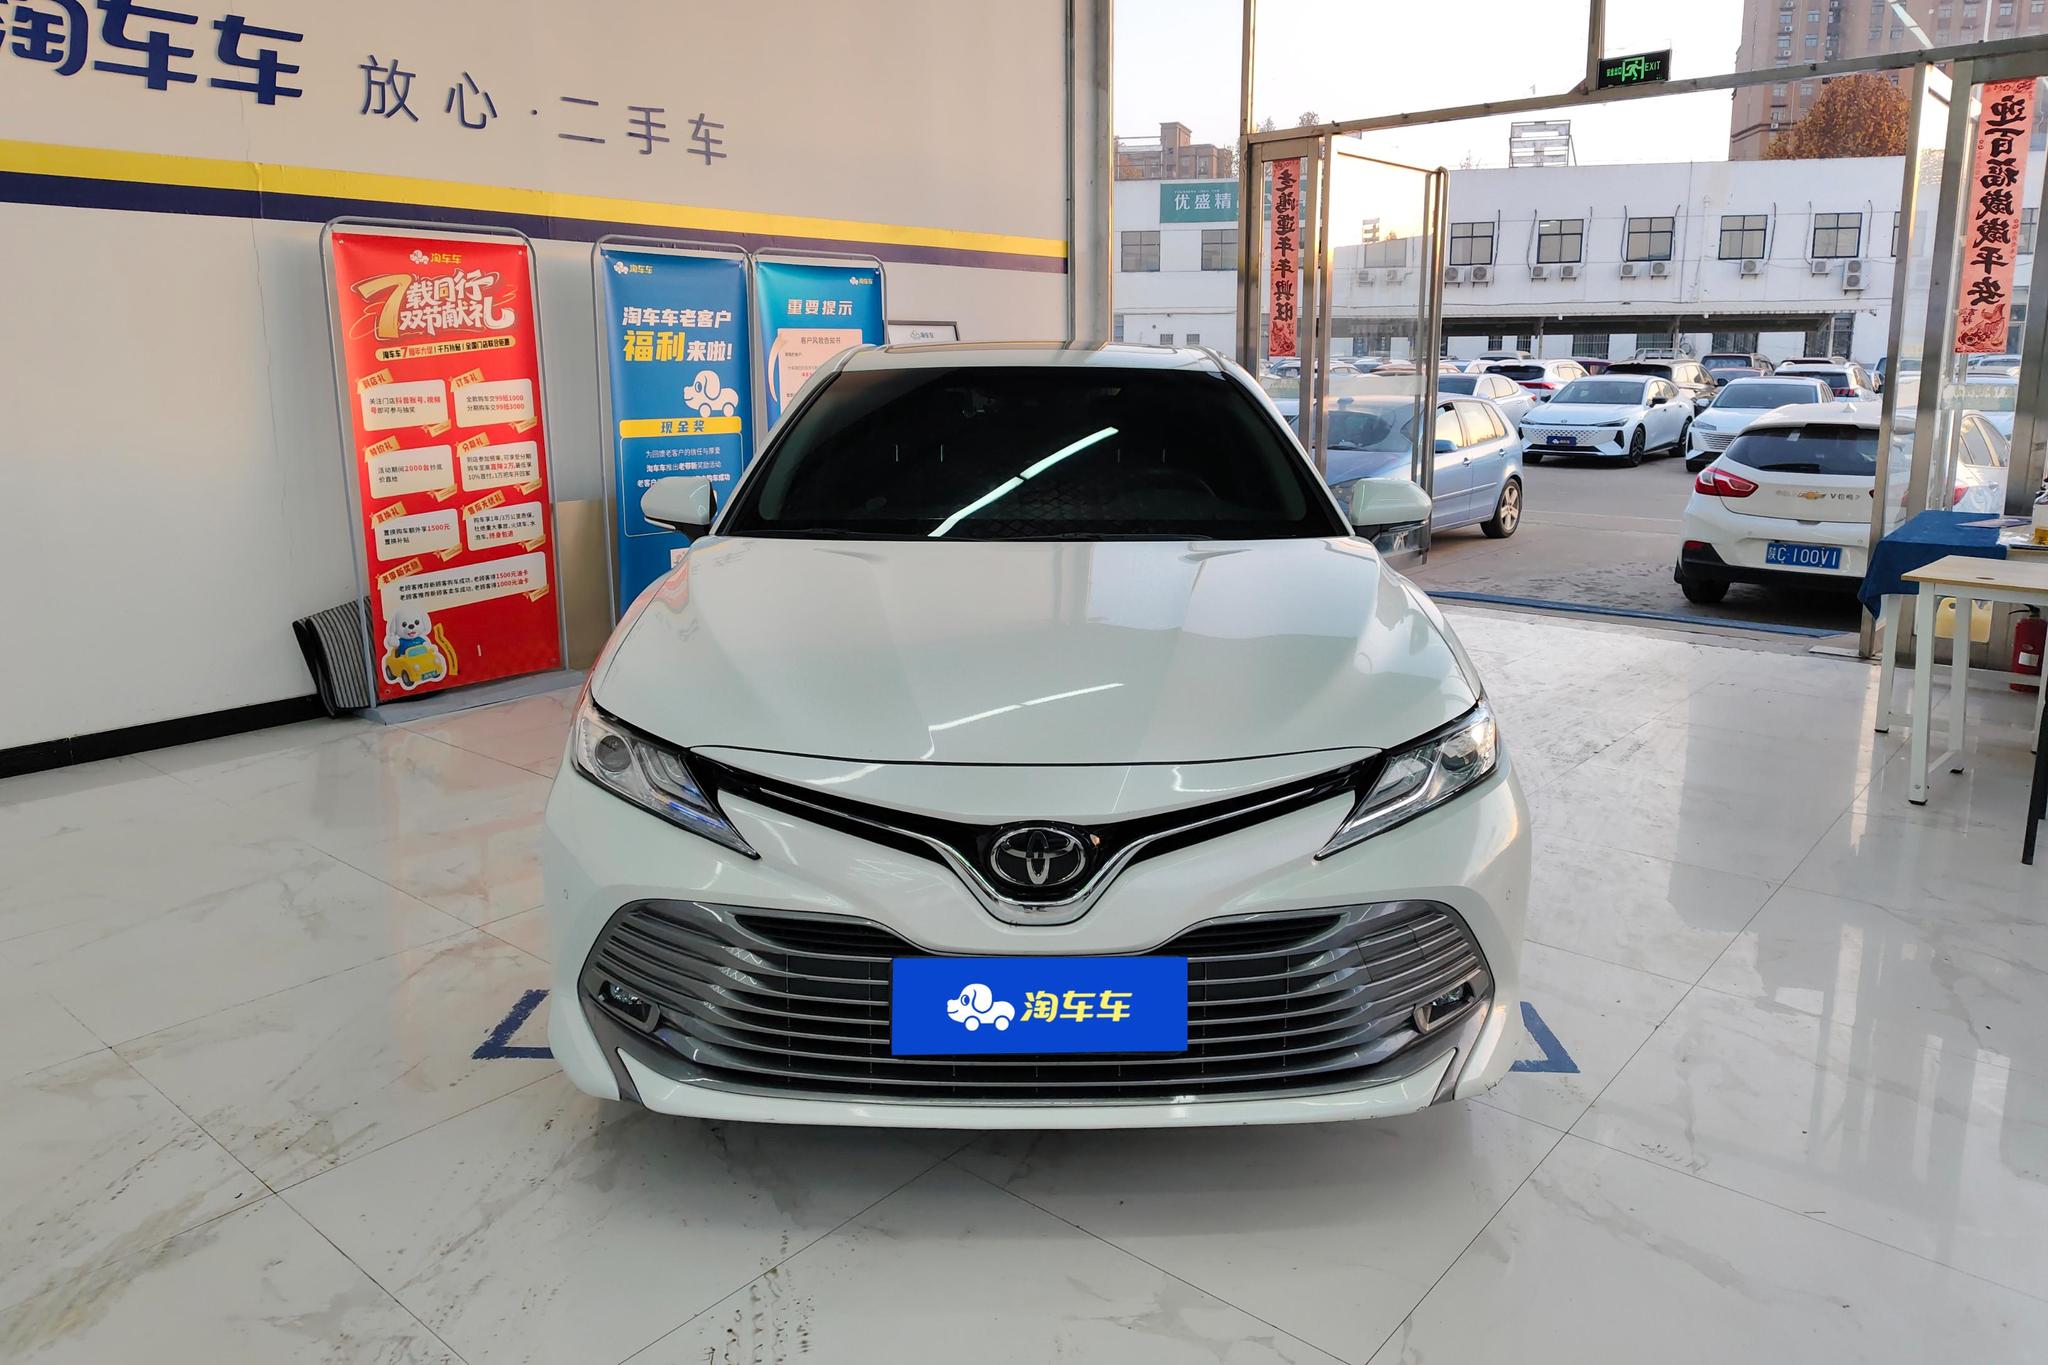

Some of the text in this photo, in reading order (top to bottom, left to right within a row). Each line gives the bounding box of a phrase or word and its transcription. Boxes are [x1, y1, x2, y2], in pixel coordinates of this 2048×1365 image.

[0, 0, 303, 105] 淘车车
[1645, 61, 1661, 71] EXIT
[1174, 192, 1239, 211] 优盛精
[431, 252, 462, 265] 淘车车
[629, 263, 654, 275] 淘车车
[787, 298, 853, 316] 重要提示
[399, 296, 516, 336] 双节献礼
[622, 306, 732, 328] 淘车车老客户
[800, 336, 841, 345] 客户风险告知书
[456, 373, 479, 389] 订车礼
[660, 420, 706, 435] 现金奖
[370, 441, 394, 457] 特价礼
[646, 460, 722, 473] 淘车车推出老带新奖励活动
